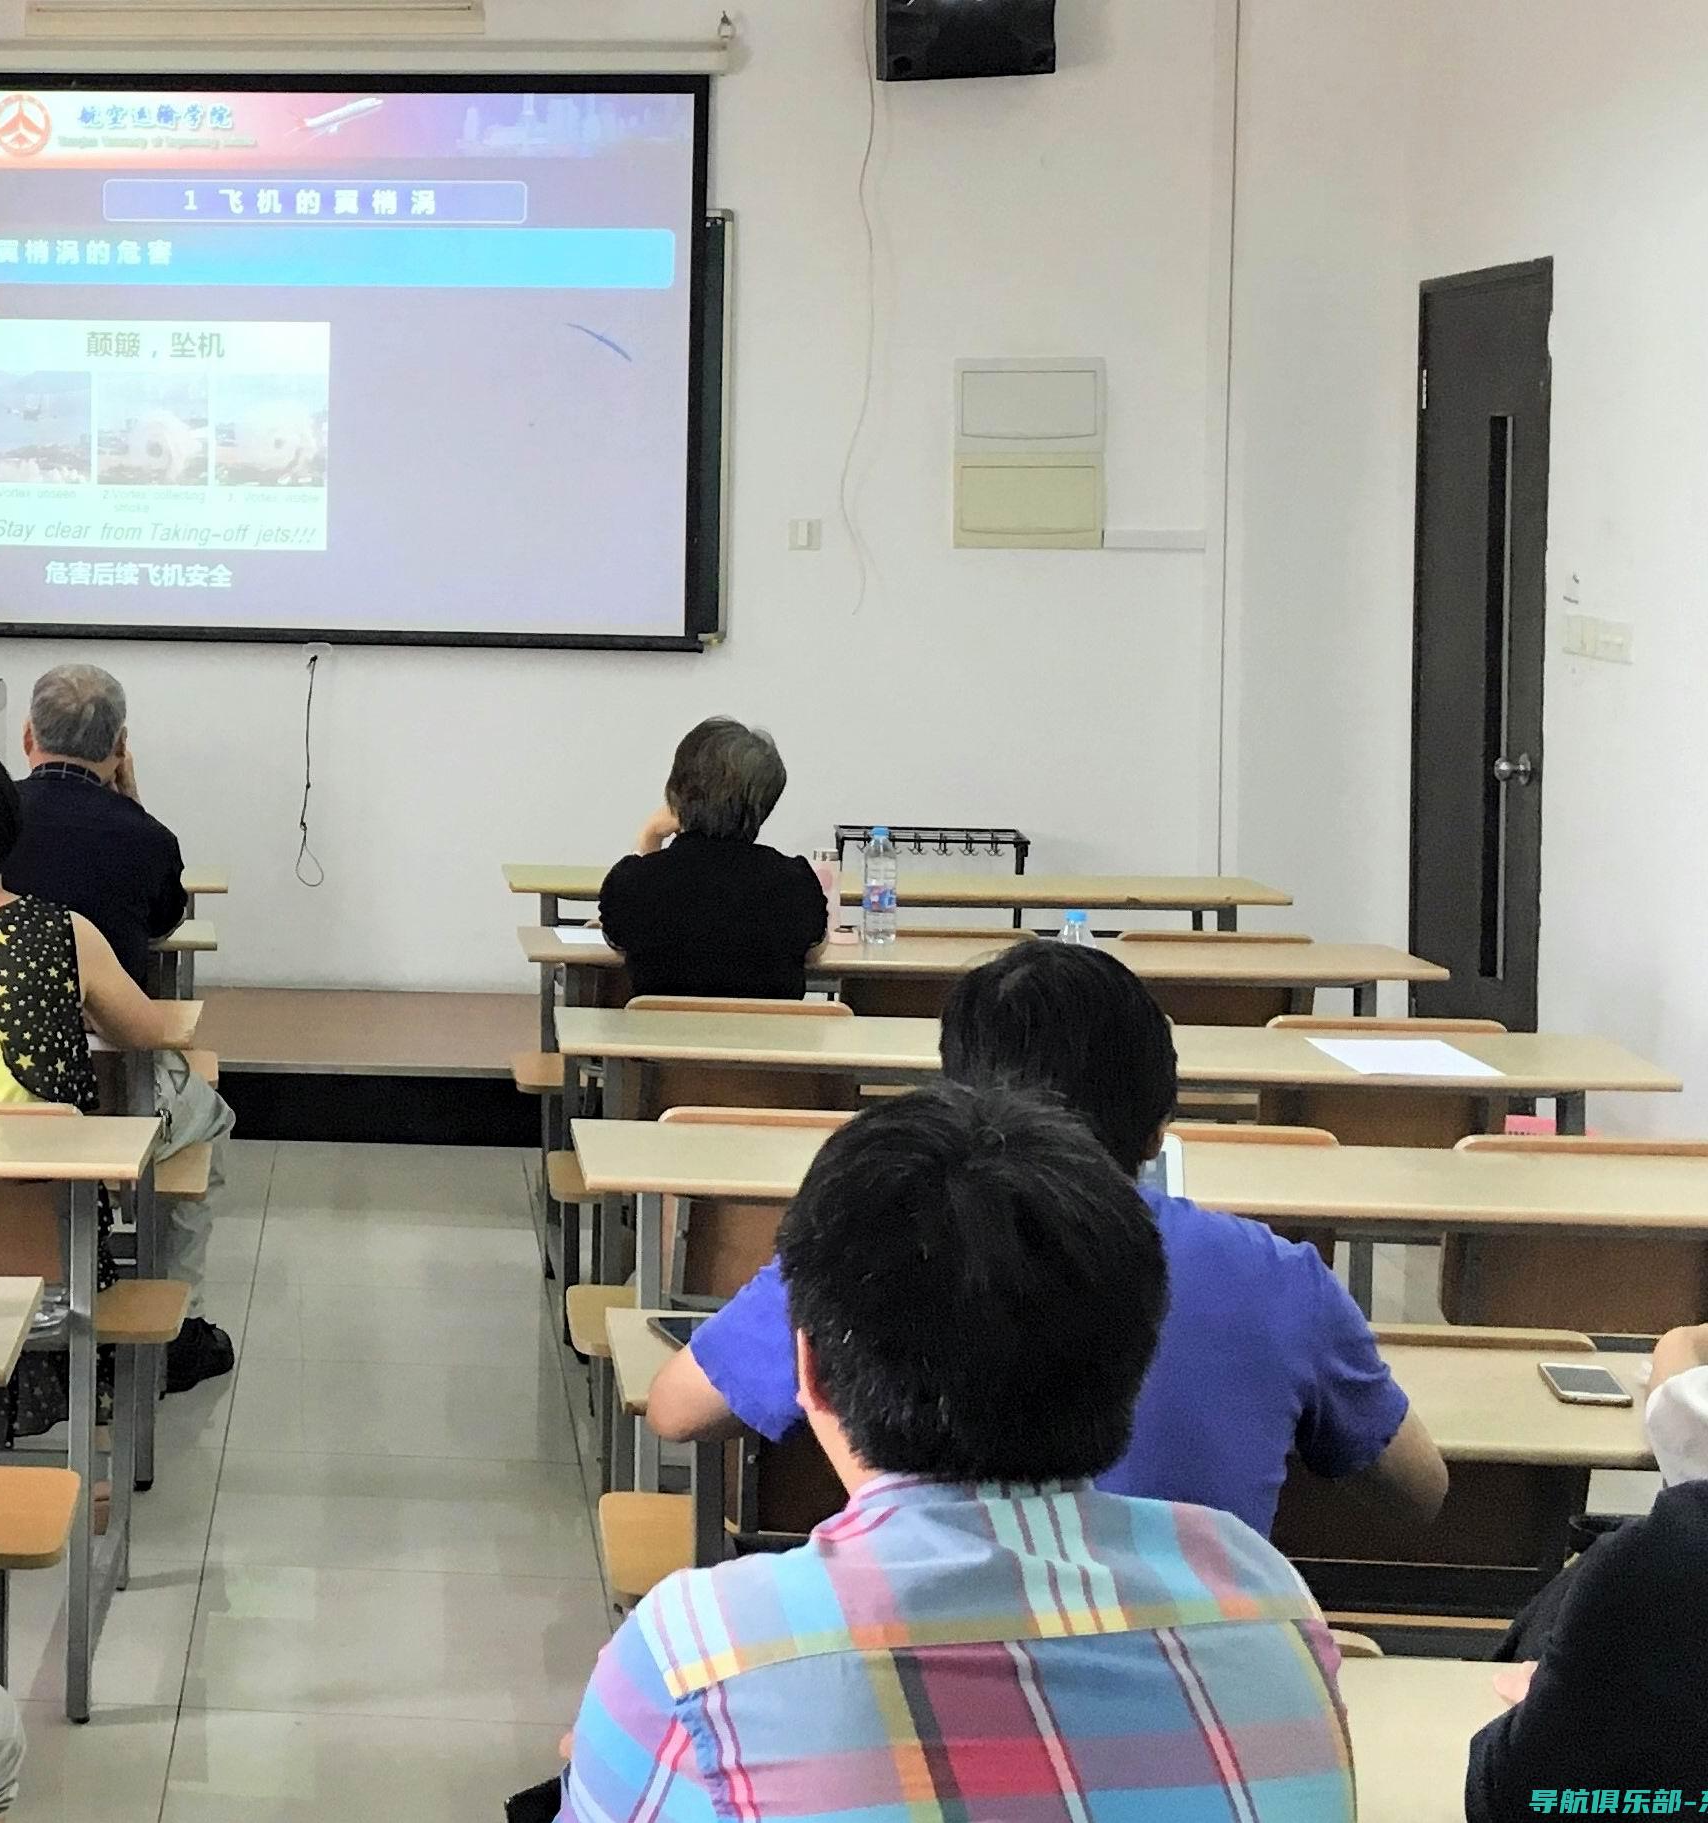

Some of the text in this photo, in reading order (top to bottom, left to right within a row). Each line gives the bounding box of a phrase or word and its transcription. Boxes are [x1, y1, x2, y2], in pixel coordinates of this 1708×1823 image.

[78, 103, 234, 129] 航空运输学院
[184, 190, 198, 211] 1
[43, 520, 91, 539] clear
[99, 520, 142, 541] from
[149, 522, 250, 547] Taking-off
[255, 525, 317, 546] jets!!!
[45, 560, 234, 588] 危害后续飞机安全
